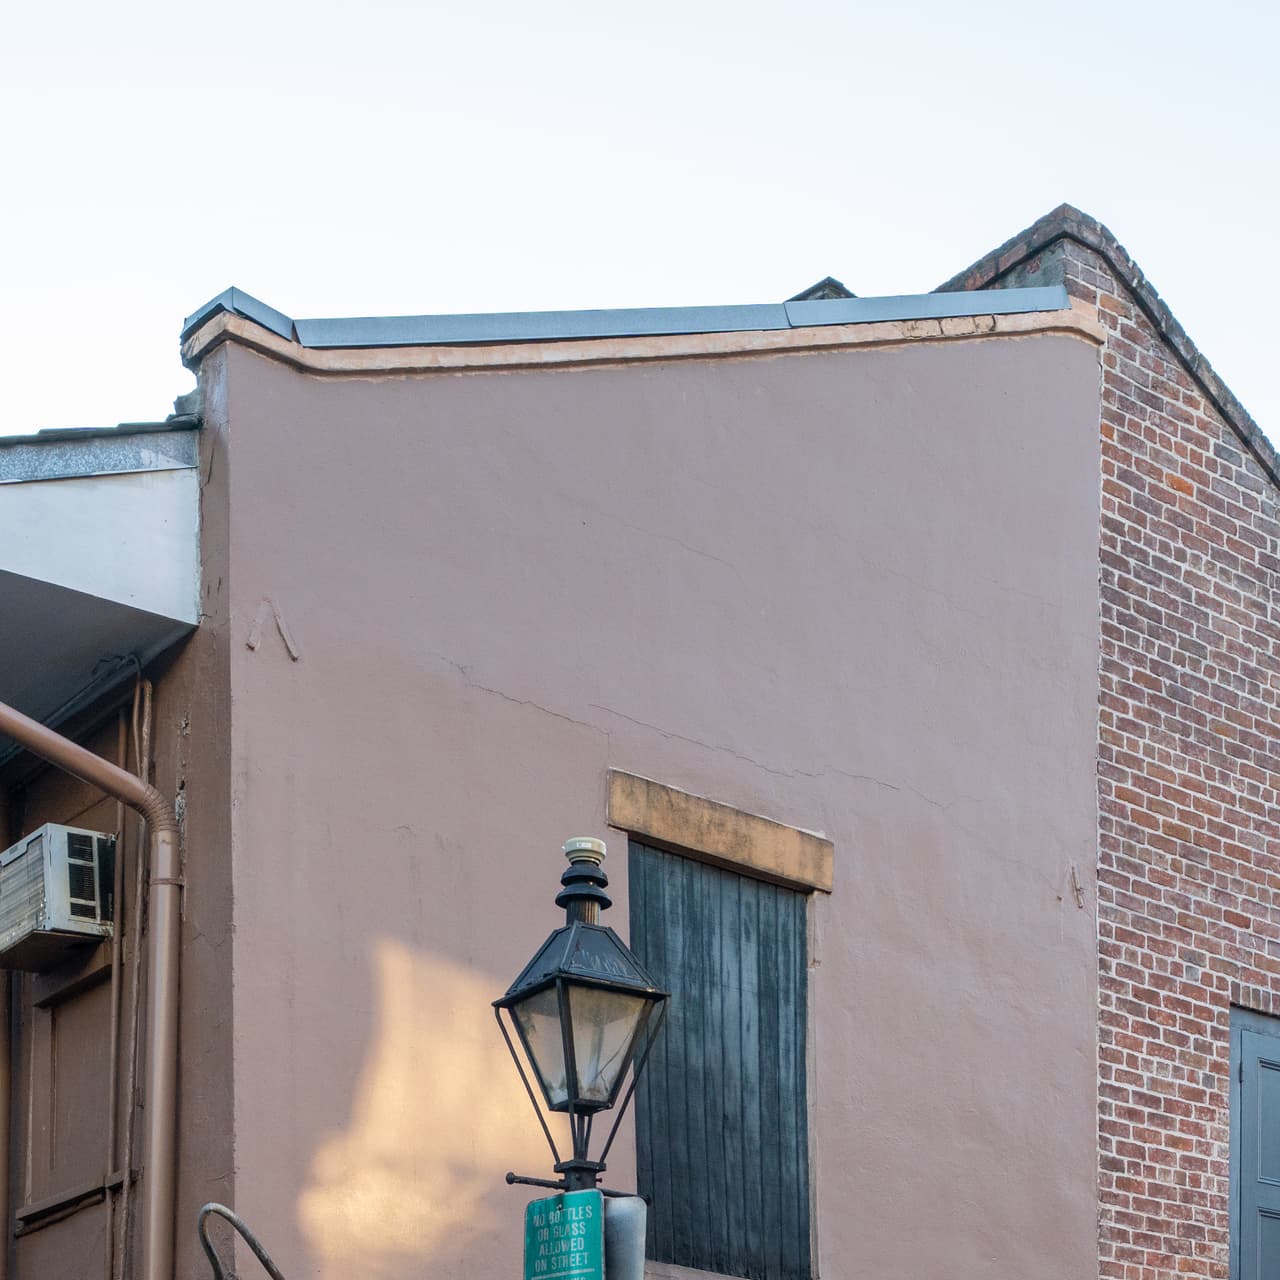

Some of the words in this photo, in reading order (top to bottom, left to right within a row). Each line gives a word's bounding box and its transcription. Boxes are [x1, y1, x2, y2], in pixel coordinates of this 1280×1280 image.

[533, 1214, 545, 1227] NO
[538, 1228, 549, 1241] OR
[553, 1221, 586, 1238] GLASS
[539, 1237, 585, 1256] ALLOWED
[535, 1259, 547, 1272] ON
[551, 1252, 590, 1270] STREET
